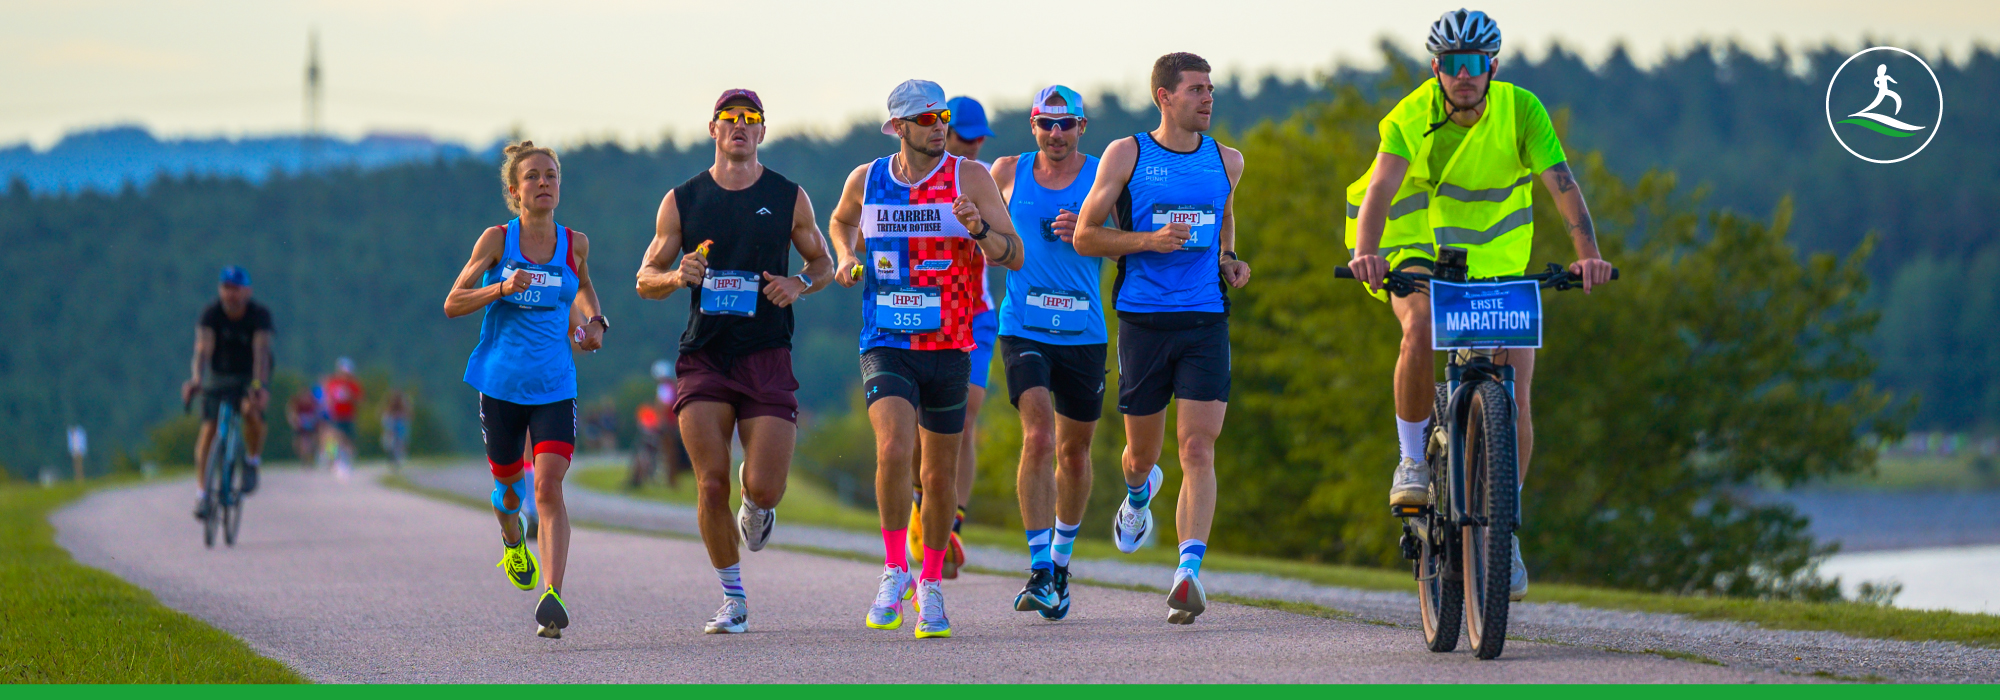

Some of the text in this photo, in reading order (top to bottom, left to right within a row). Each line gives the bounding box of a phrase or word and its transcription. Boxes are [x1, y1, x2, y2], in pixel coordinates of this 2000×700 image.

[1145, 166, 1168, 176] GEH
[877, 209, 941, 222] LA CARRERA
[877, 223, 941, 232] TRITEAM ROTHSEE
[514, 289, 541, 303] 303
[714, 294, 739, 308] 147
[1470, 298, 1504, 310] ERSTE
[893, 312, 922, 326] 355
[1051, 313, 1061, 327] 6
[1446, 310, 1530, 331] MARATHON
